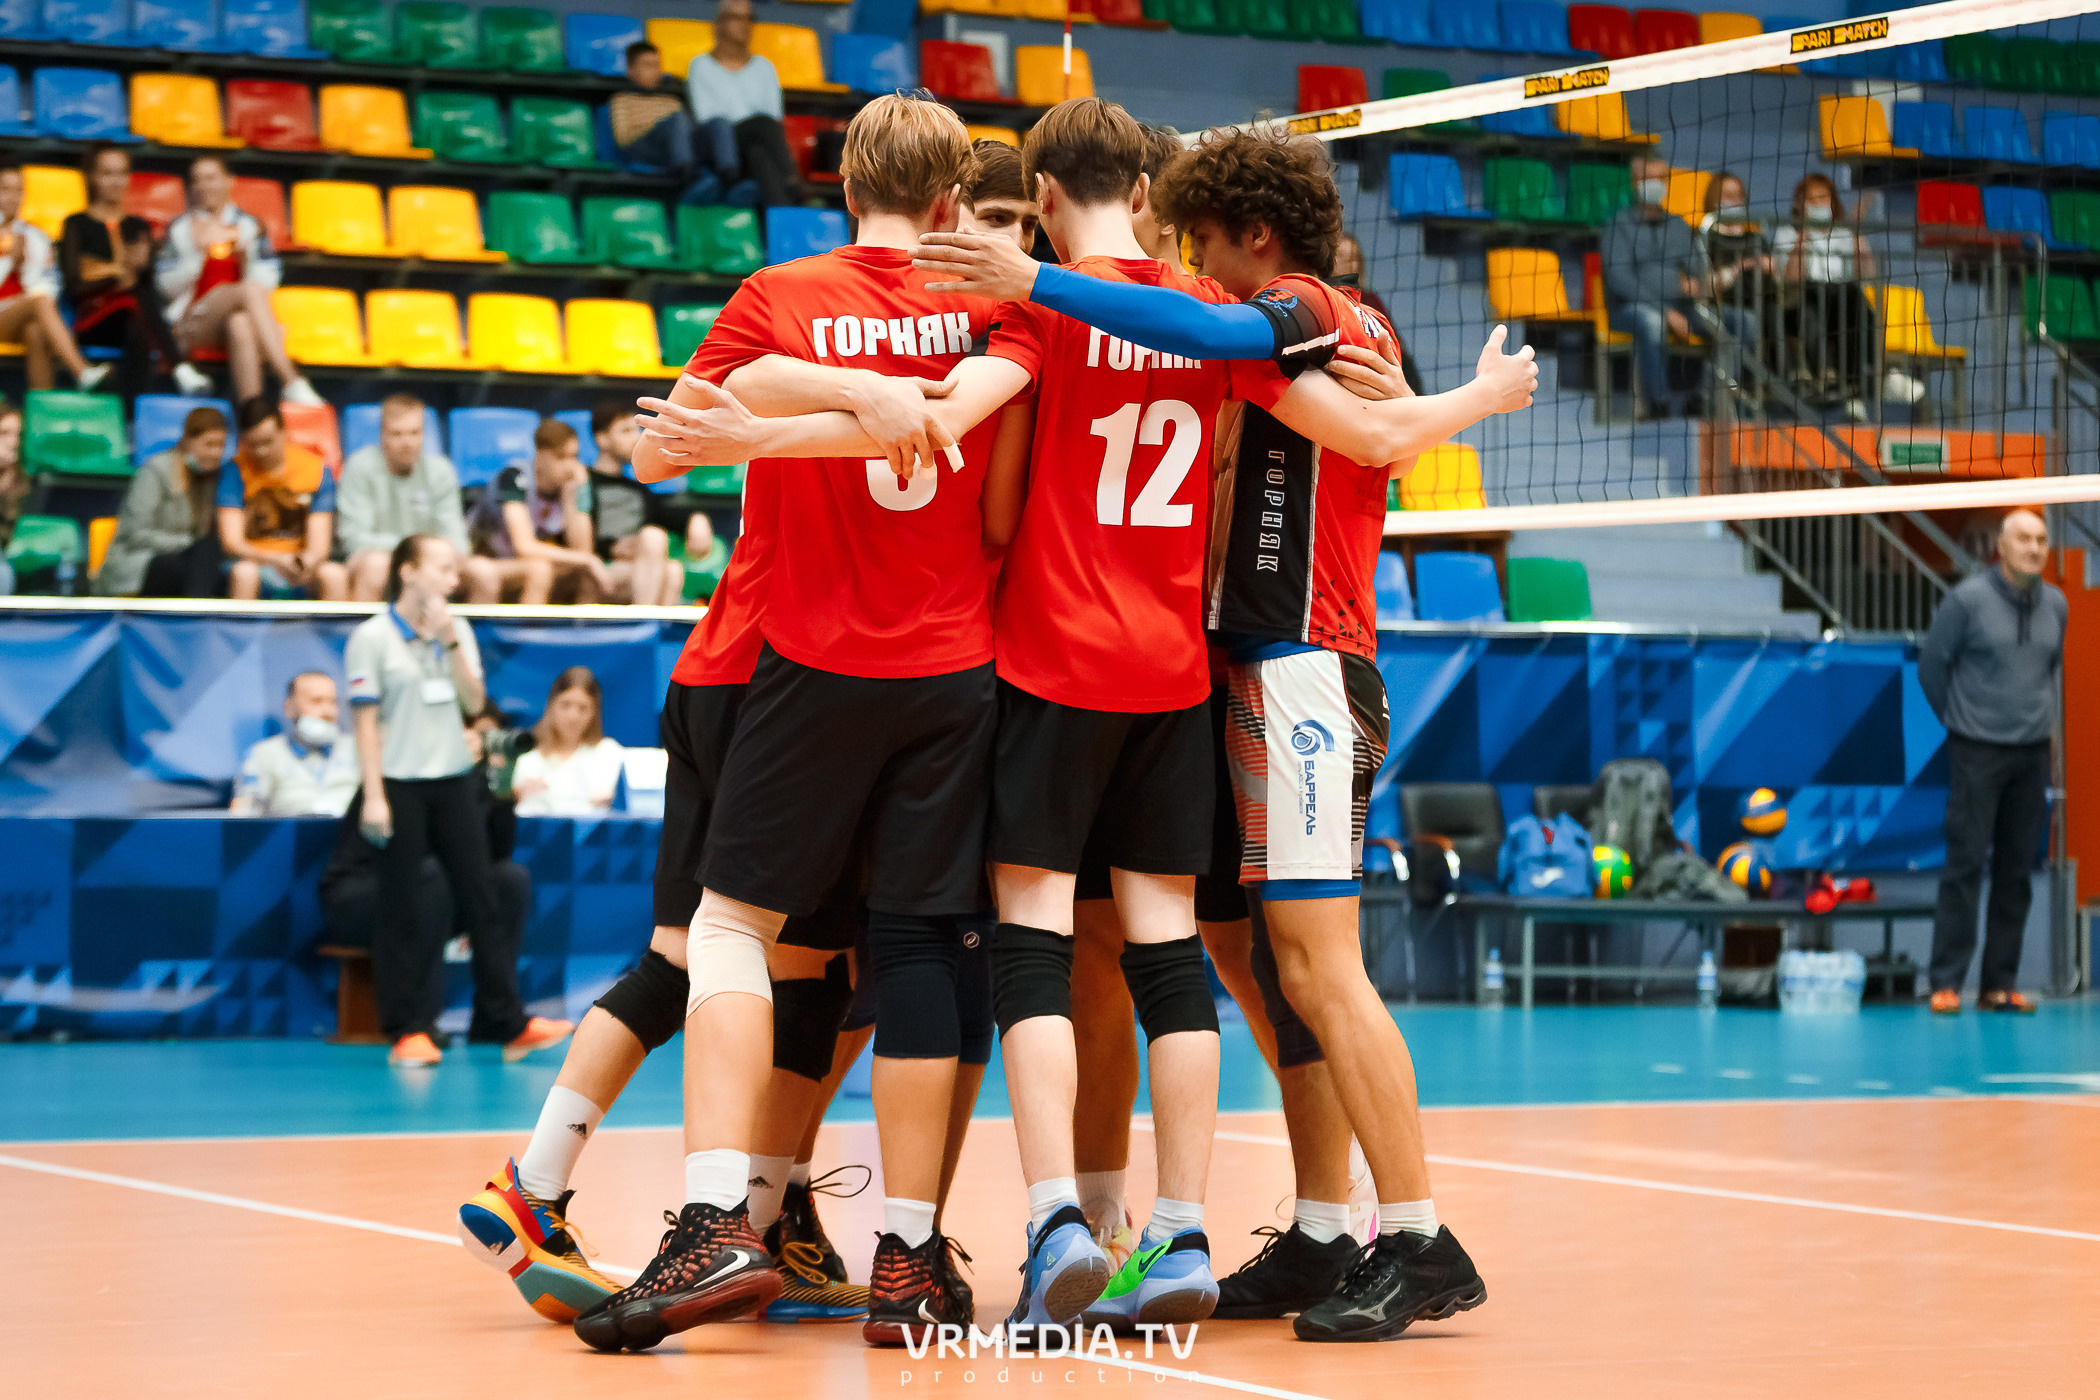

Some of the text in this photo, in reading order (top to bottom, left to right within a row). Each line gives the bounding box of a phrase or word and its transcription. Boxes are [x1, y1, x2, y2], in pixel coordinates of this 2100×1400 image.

[1833, 19, 1887, 44] MATCH
[812, 312, 973, 358] ГОРНЯК
[1089, 398, 1202, 528] 12
[1256, 449, 1285, 573] ГОРНЯК
[1304, 760, 1316, 835] БАРРЕЛЬ
